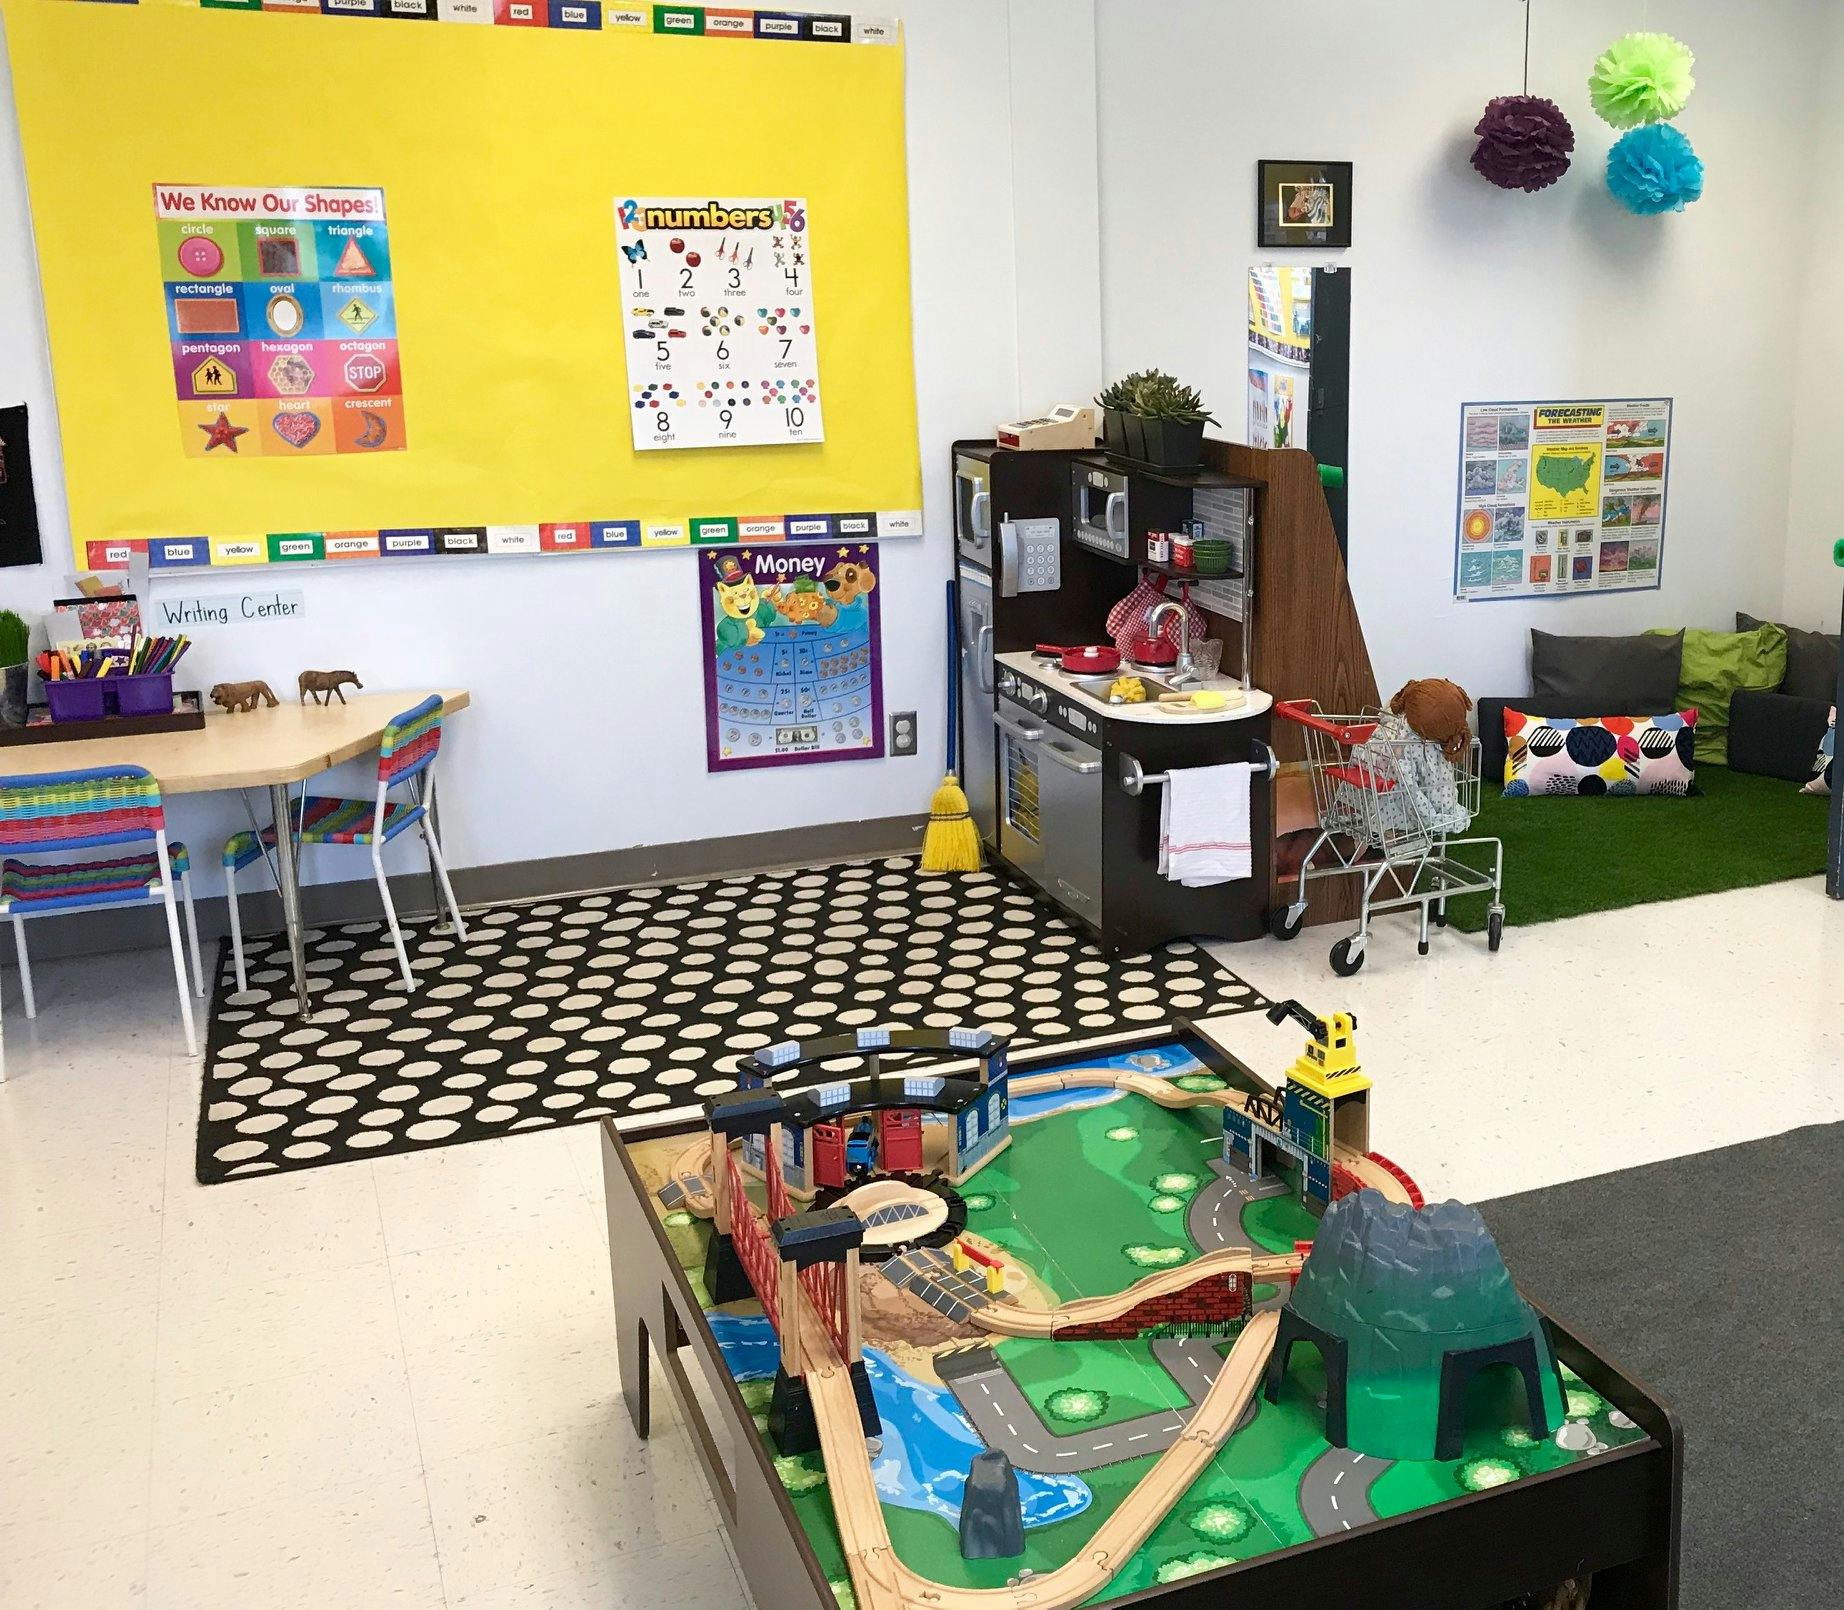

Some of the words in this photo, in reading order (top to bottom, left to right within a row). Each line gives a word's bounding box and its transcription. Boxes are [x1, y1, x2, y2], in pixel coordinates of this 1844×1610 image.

[394, 0, 423, 9] black
[453, 4, 478, 13] white
[512, 7, 530, 16] red
[564, 9, 585, 19] blue
[615, 13, 641, 23] yellow
[666, 16, 692, 26] green
[713, 19, 744, 29] orange
[765, 22, 793, 32] purple
[815, 24, 839, 33] black
[863, 26, 885, 35] white
[160, 192, 195, 211] We
[200, 192, 257, 212] Know
[262, 193, 298, 212] Our
[304, 193, 379, 217] Shapes!
[646, 201, 774, 229] numbers
[181, 224, 214, 235] circle
[255, 226, 297, 238] square
[328, 225, 373, 238] triangle
[638, 269, 643, 289] 1
[679, 269, 694, 289] 2
[728, 268, 741, 288] 3
[785, 268, 799, 287] 4
[175, 283, 233, 298] rectangle
[270, 283, 295, 294] oval
[331, 283, 382, 294] rhombus
[632, 290, 650, 298] one
[678, 289, 695, 297] two
[724, 288, 746, 296] three
[786, 287, 804, 296] four
[182, 343, 241, 356] pentagon
[261, 341, 313, 355] hexagon
[339, 341, 386, 354] octagon
[657, 341, 670, 361] 5
[716, 340, 730, 360] 6
[778, 339, 793, 359] 7
[655, 362, 672, 370] five
[718, 362, 730, 370] six
[774, 361, 798, 369] seven
[349, 365, 382, 380] STOP
[206, 402, 230, 412] star
[279, 399, 310, 411] heart
[344, 398, 393, 409] crescent
[785, 407, 804, 427] 10
[1538, 407, 1603, 418] FORECASTING
[656, 411, 670, 432] 8
[719, 409, 733, 430] 9
[653, 432, 675, 443] eight
[718, 431, 737, 439] nine
[789, 428, 803, 436] ten
[110, 549, 128, 559] red
[167, 547, 190, 556] blue
[225, 545, 253, 555] yellow
[281, 543, 311, 554] green
[334, 539, 369, 550] orange
[392, 538, 422, 549] purple
[447, 536, 474, 546] black
[502, 535, 525, 545] white
[557, 531, 573, 541] red
[605, 530, 625, 539] blue
[653, 527, 678, 538] yellow
[701, 526, 726, 537] green
[746, 524, 775, 535] orange
[795, 523, 822, 534] purple
[842, 521, 866, 530] black
[889, 520, 909, 529] white
[755, 554, 826, 577] Money
[162, 599, 229, 625] Writing
[240, 593, 299, 618] Center
